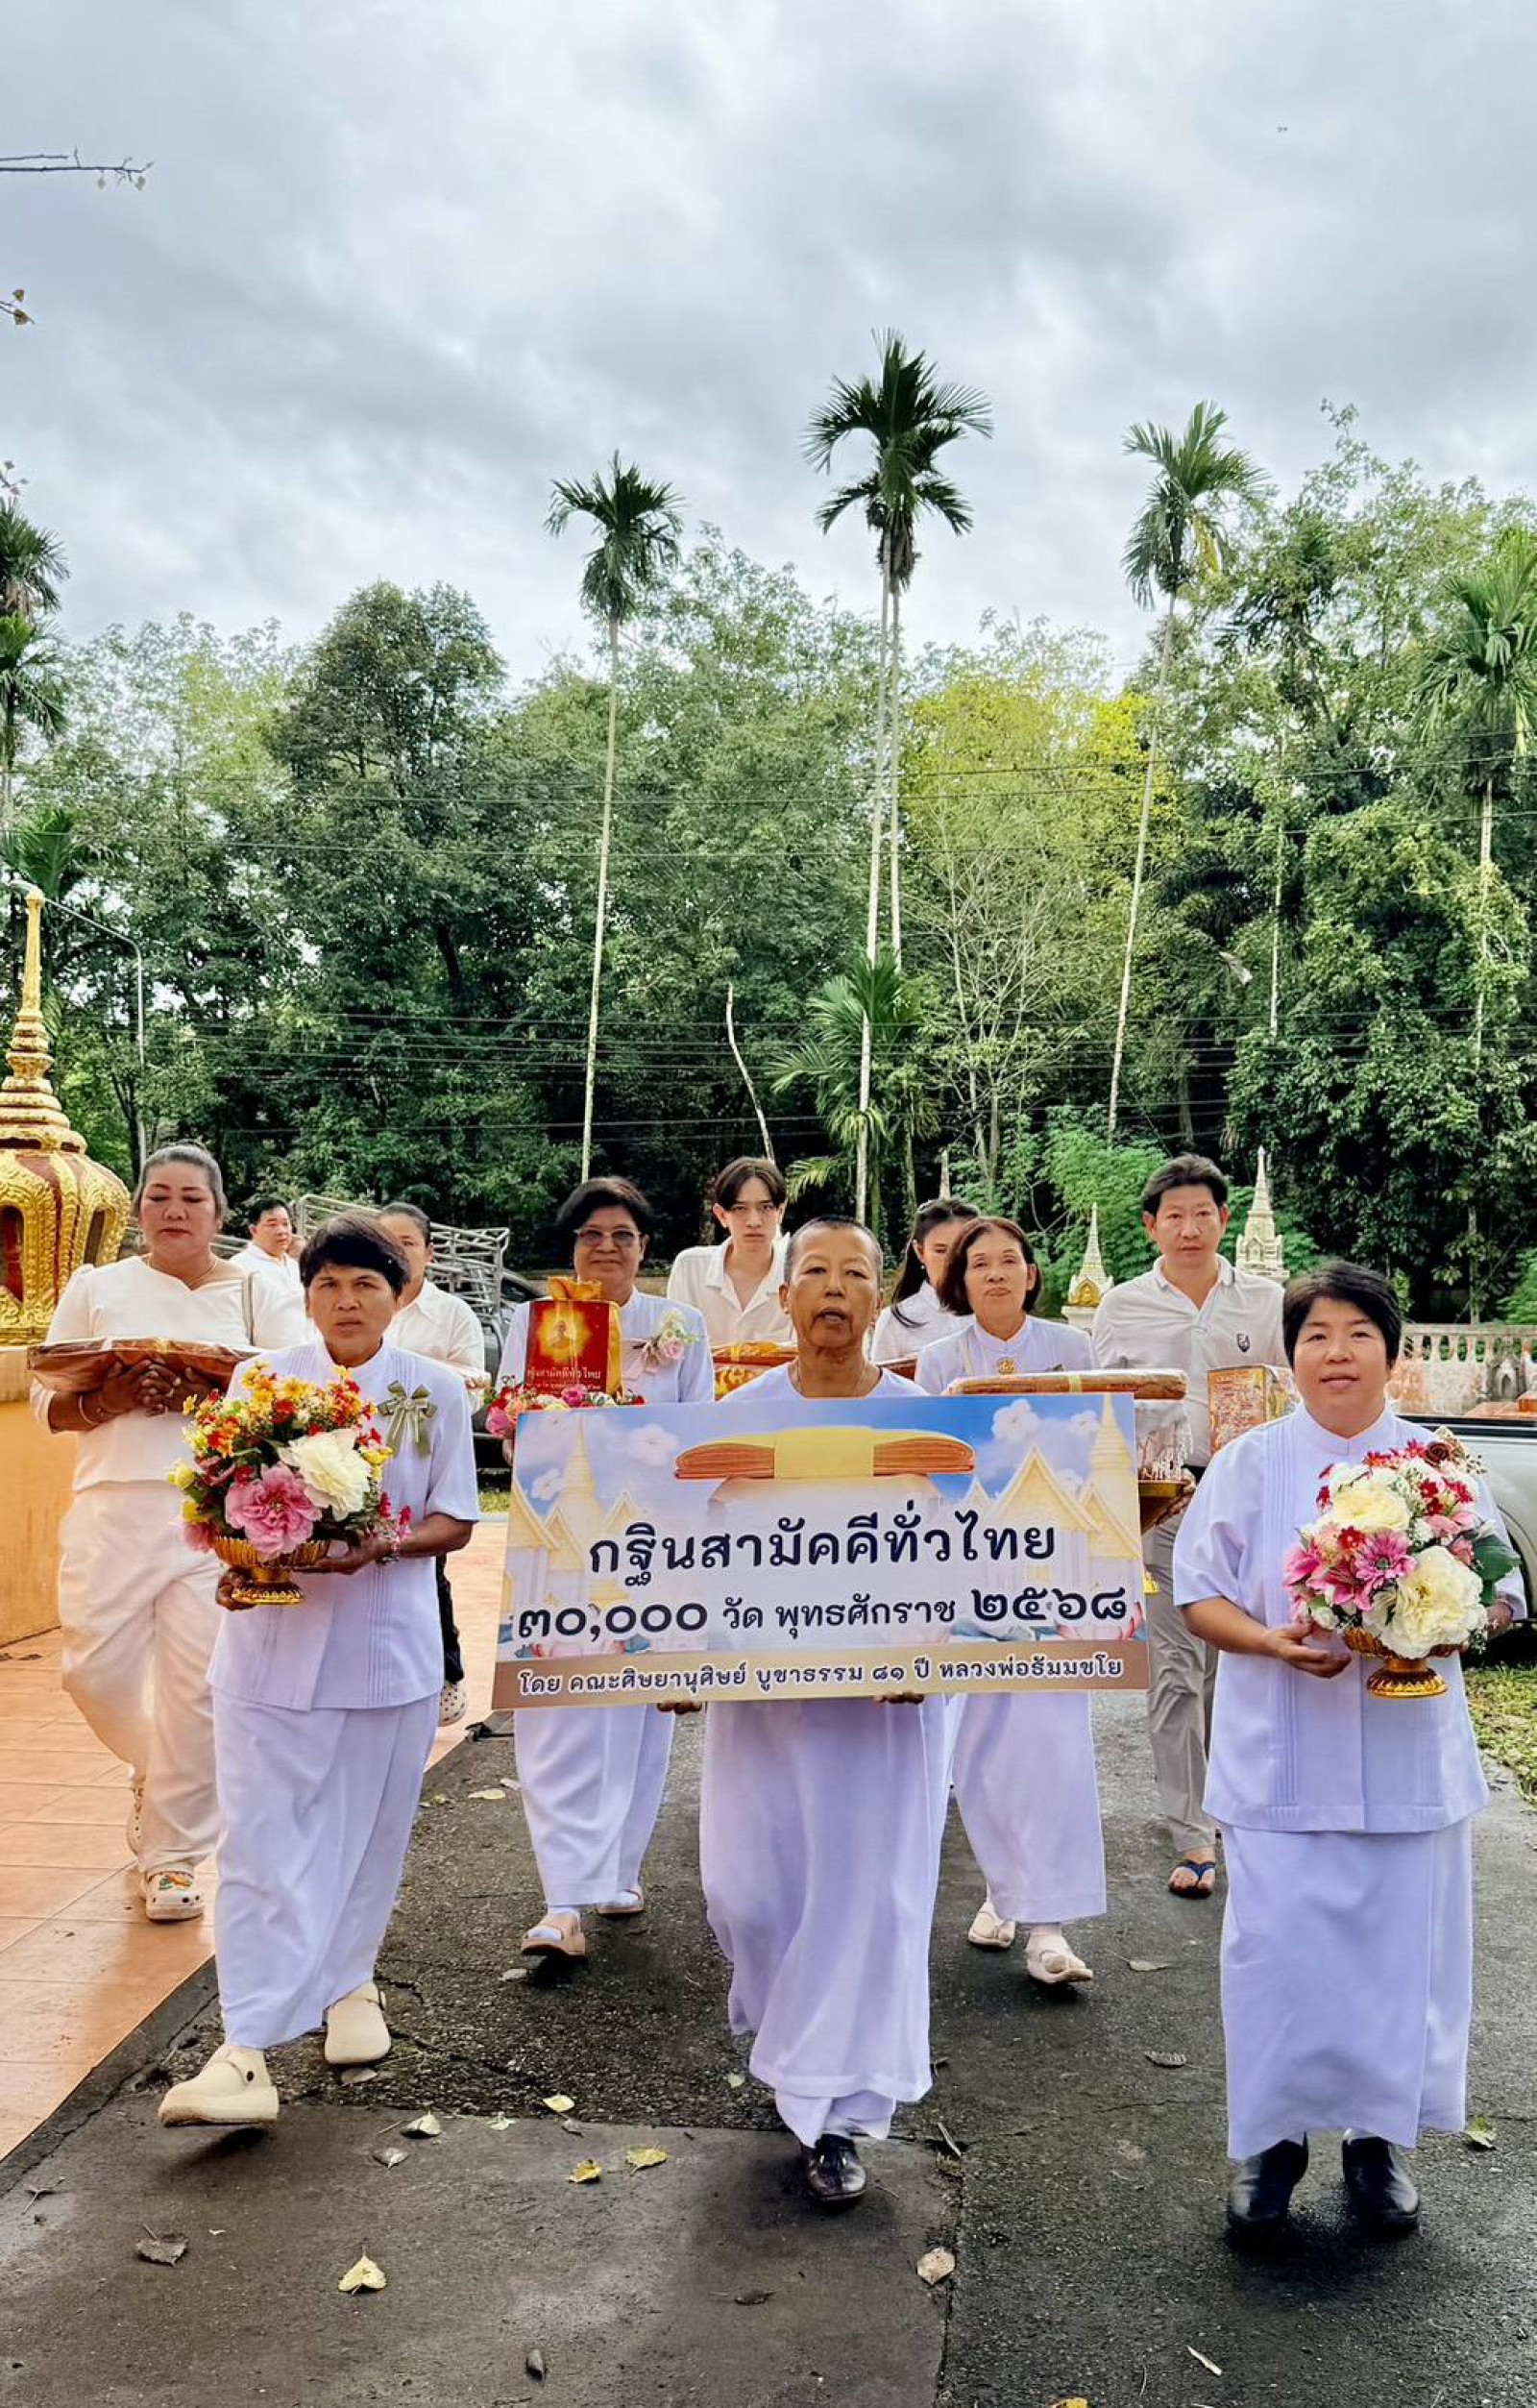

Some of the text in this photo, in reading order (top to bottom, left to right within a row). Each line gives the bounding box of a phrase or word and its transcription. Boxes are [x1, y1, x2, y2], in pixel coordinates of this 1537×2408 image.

[589, 1500, 1055, 1586] กฐินสามัคคีทั่วไทย
[519, 1586, 1127, 1641] ๓๐,๐๐๐ วัด พุทธศักราช ๒๕๖๘
[520, 1672, 560, 1693] โดย
[570, 1661, 746, 1693] คณะศิษยานุศิษย์
[872, 1664, 905, 1682] ๘๑
[915, 1657, 929, 1680] ปี
